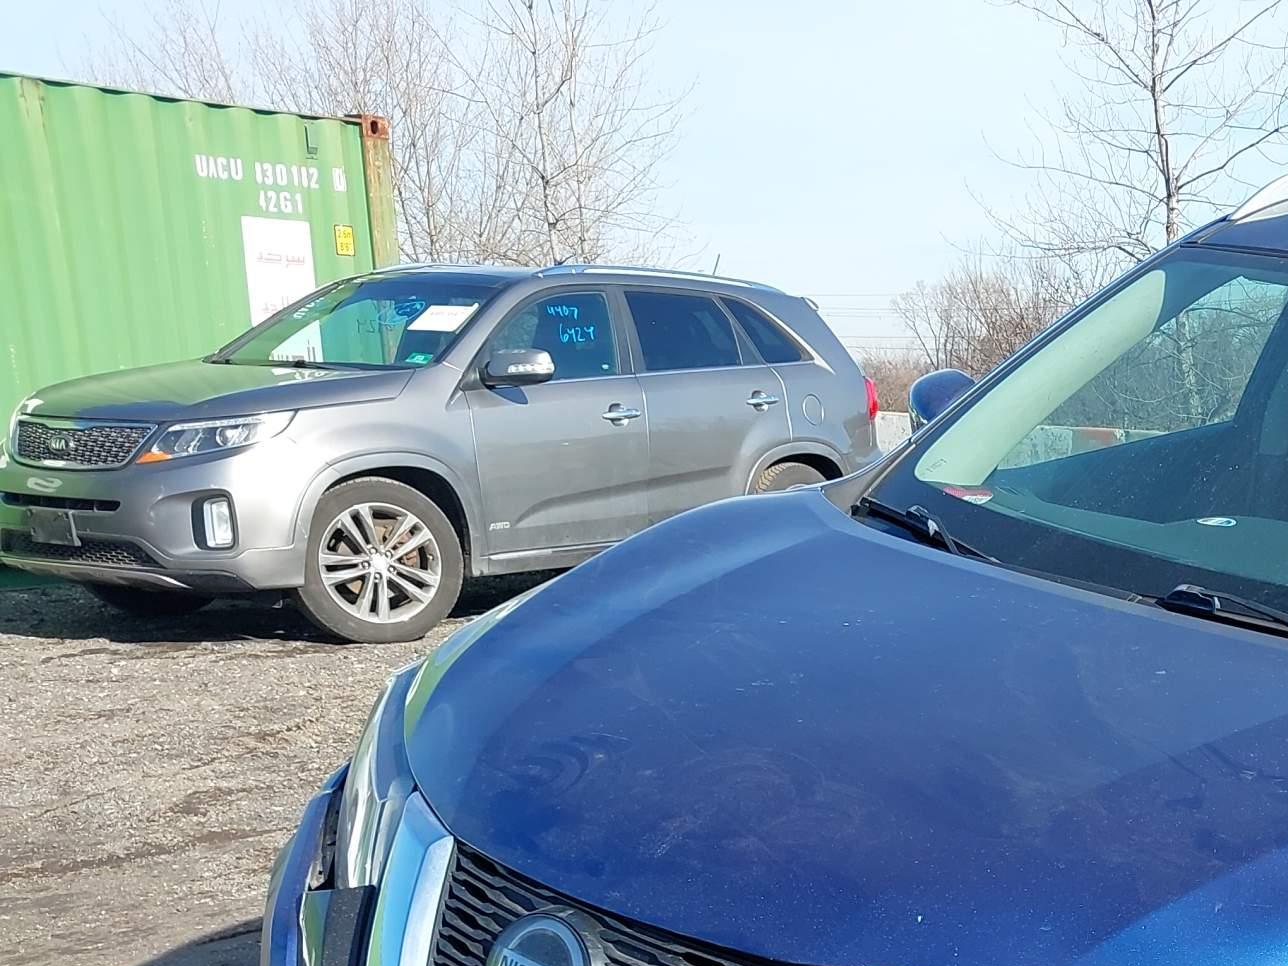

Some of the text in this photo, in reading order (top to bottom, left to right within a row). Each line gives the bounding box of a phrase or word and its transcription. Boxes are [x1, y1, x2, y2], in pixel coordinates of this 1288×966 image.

[194, 154, 243, 181] UACU
[546, 305, 578, 321] 4407
[559, 323, 596, 343] 6424
[51, 438, 66, 450] KIA
